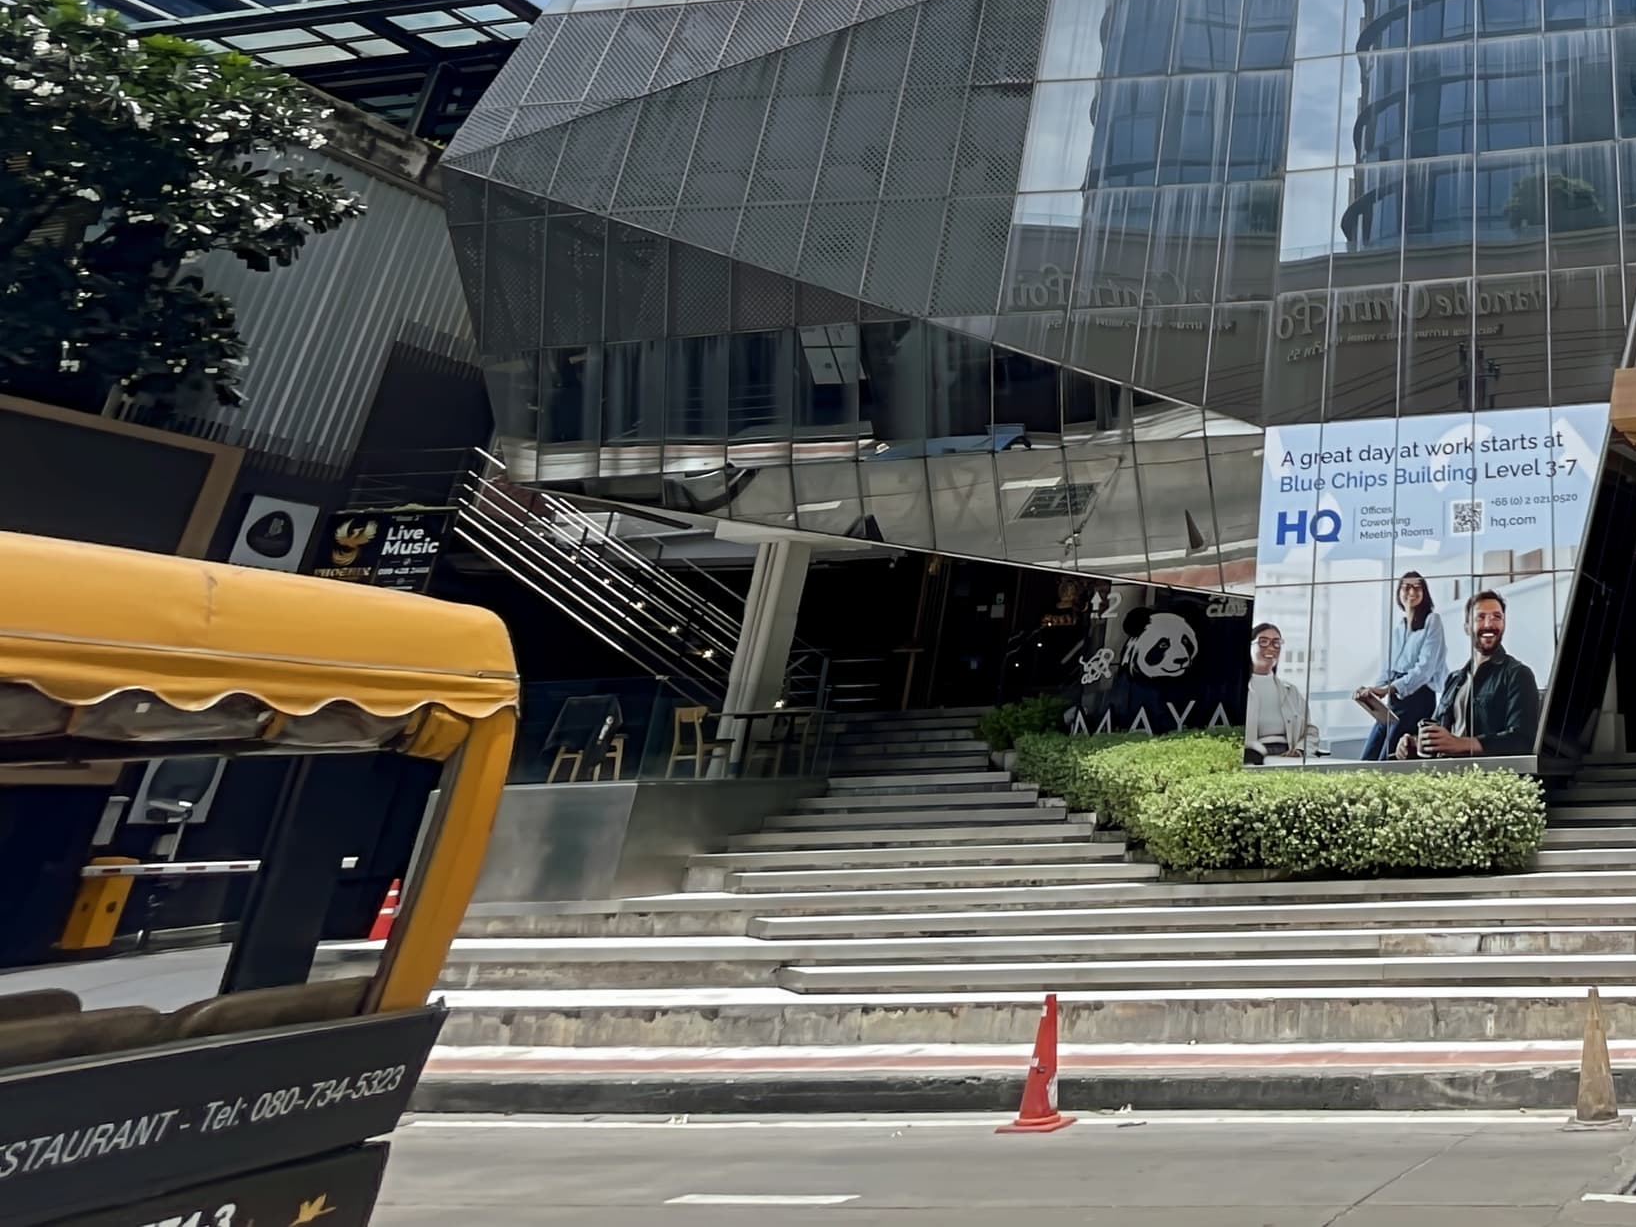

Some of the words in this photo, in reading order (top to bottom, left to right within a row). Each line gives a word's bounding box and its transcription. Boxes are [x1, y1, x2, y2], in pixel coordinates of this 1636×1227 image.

[1281, 451, 1295, 466] A
[1300, 445, 1352, 469] great
[1358, 444, 1395, 465] day
[1400, 441, 1419, 458] at
[1425, 438, 1475, 456] work
[1480, 433, 1538, 452] starts
[1543, 431, 1563, 448] at
[1280, 474, 1325, 493] Blue
[1331, 470, 1387, 491] Chips
[1394, 464, 1477, 484] Building
[1484, 459, 1539, 479] Level
[1545, 459, 1577, 478] 3-7
[1361, 506, 1392, 515] Offices
[1490, 516, 1537, 529] hq.com
[386, 525, 424, 540] Live
[1276, 509, 1342, 545] HQ
[1360, 530, 1398, 540] Meeting
[1401, 528, 1434, 538] Rooms
[381, 537, 439, 555] Music
[1101, 592, 1122, 618] 2
[1071, 700, 1232, 736] MAYA
[200, 1096, 248, 1133] Tel:
[250, 1065, 407, 1122] 080-734-5323
